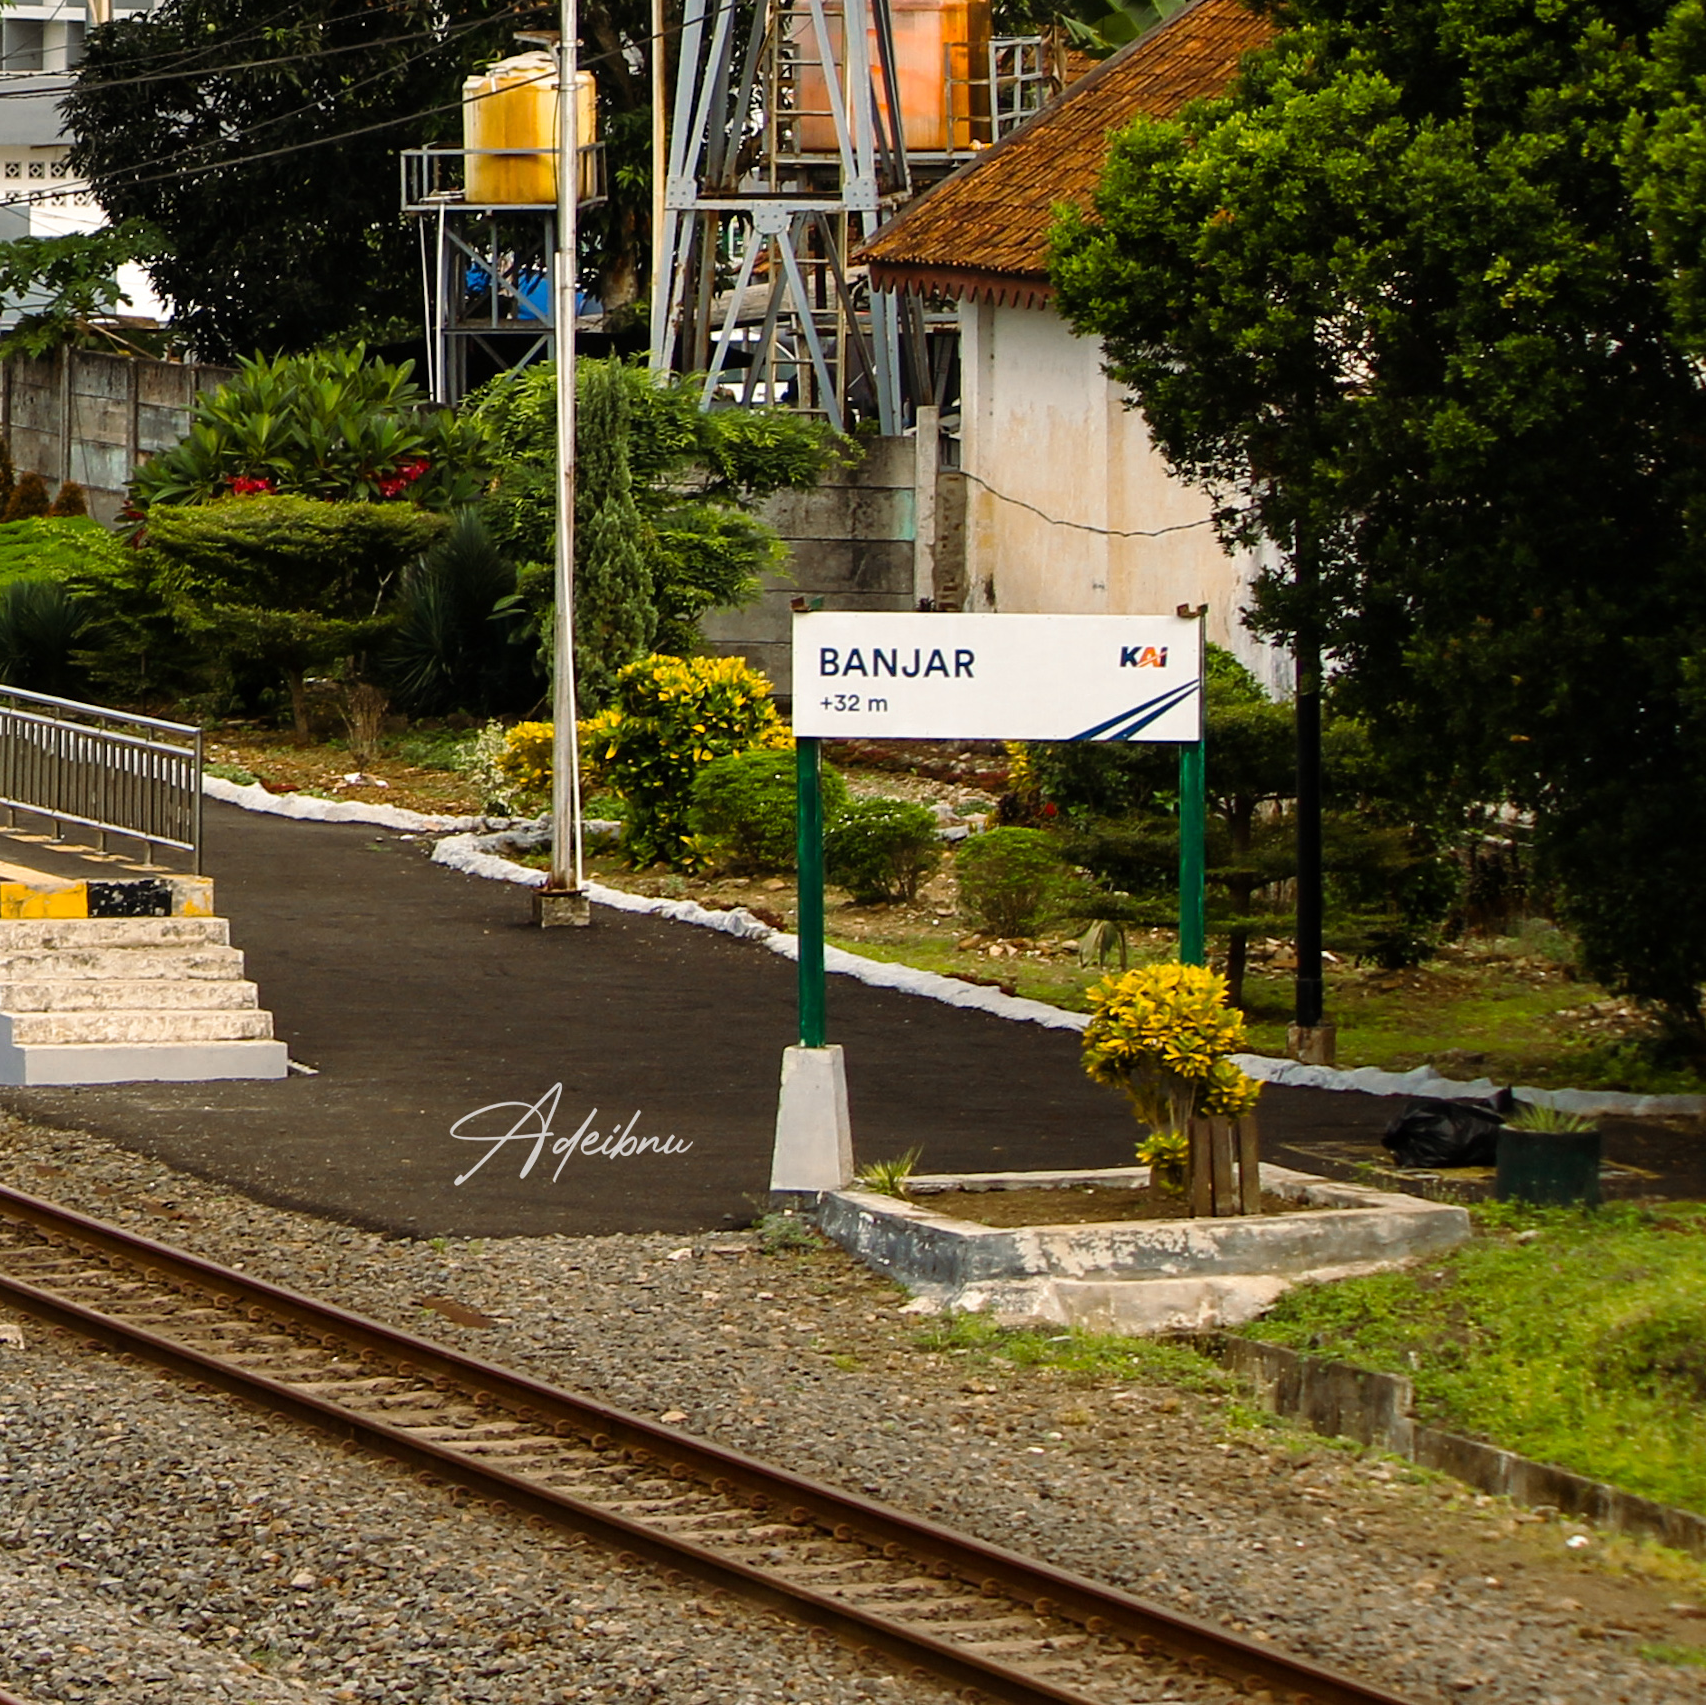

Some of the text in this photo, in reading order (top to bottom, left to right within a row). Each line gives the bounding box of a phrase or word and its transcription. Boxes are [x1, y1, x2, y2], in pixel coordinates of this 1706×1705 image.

[819, 647, 976, 679] BANJAR
[1120, 646, 1169, 668] KAI
[820, 694, 889, 712] +32 m
